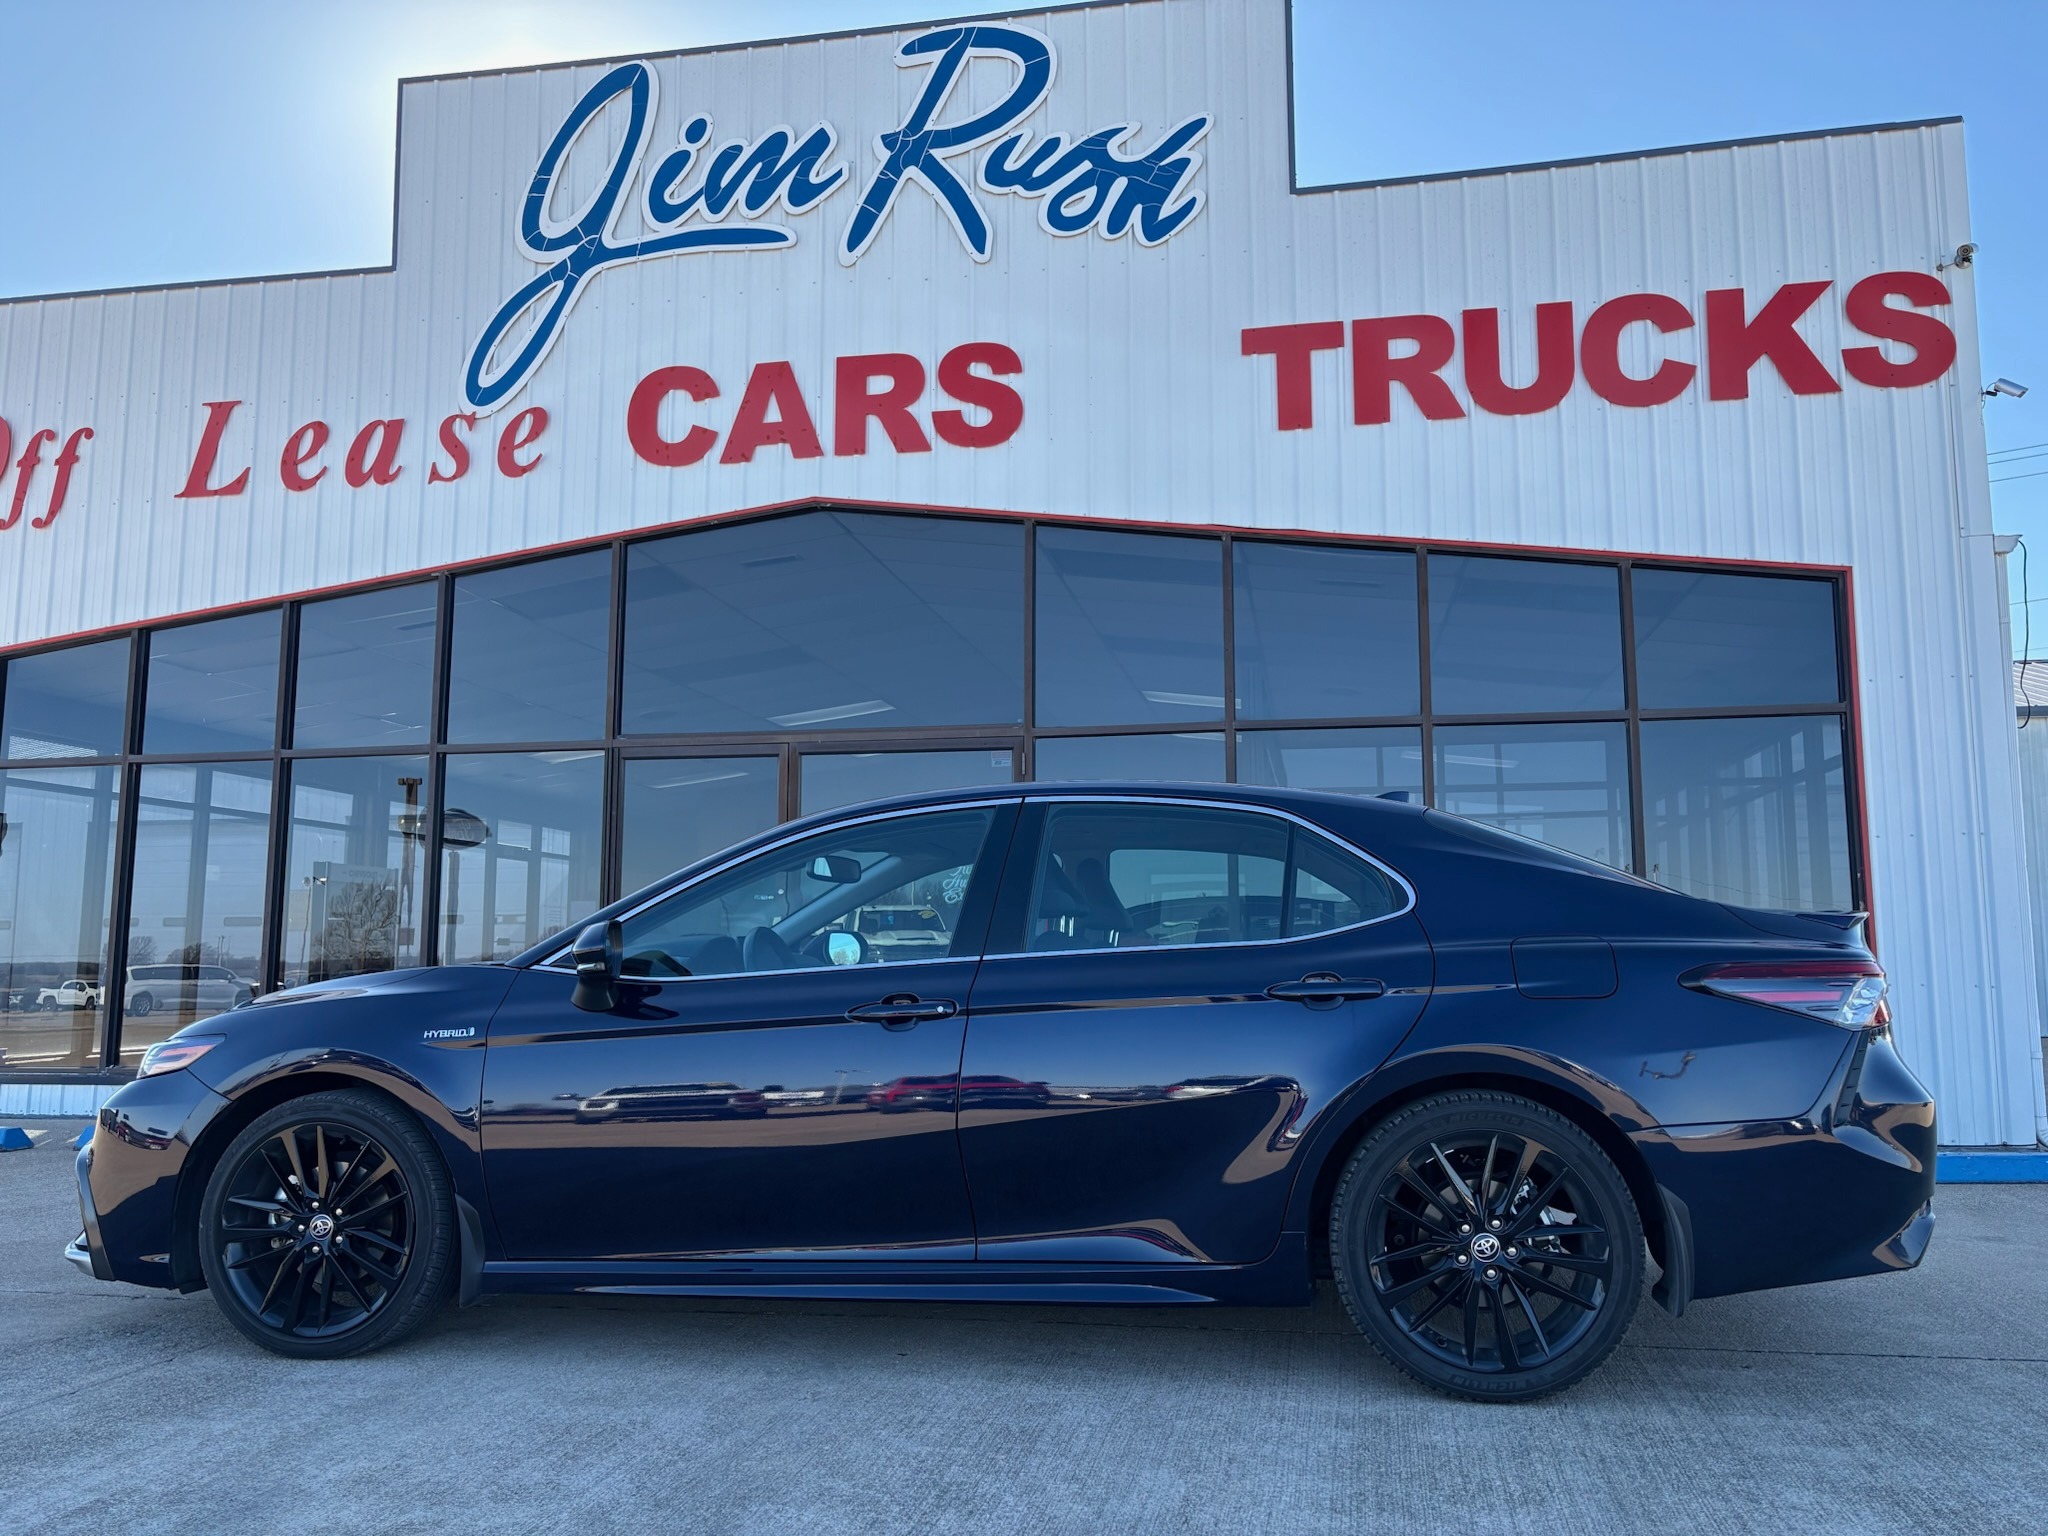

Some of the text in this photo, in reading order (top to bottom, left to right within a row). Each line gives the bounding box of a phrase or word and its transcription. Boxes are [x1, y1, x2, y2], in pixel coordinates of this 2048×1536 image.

[464, 25, 1208, 409] Jim Rush
[0, 271, 1957, 531] ff Lease CARS TRUCKS
[423, 1027, 468, 1039] HYBRID
[1449, 1111, 1522, 1127] MICHELIN
[1453, 1375, 1527, 1391] MICHELIN
